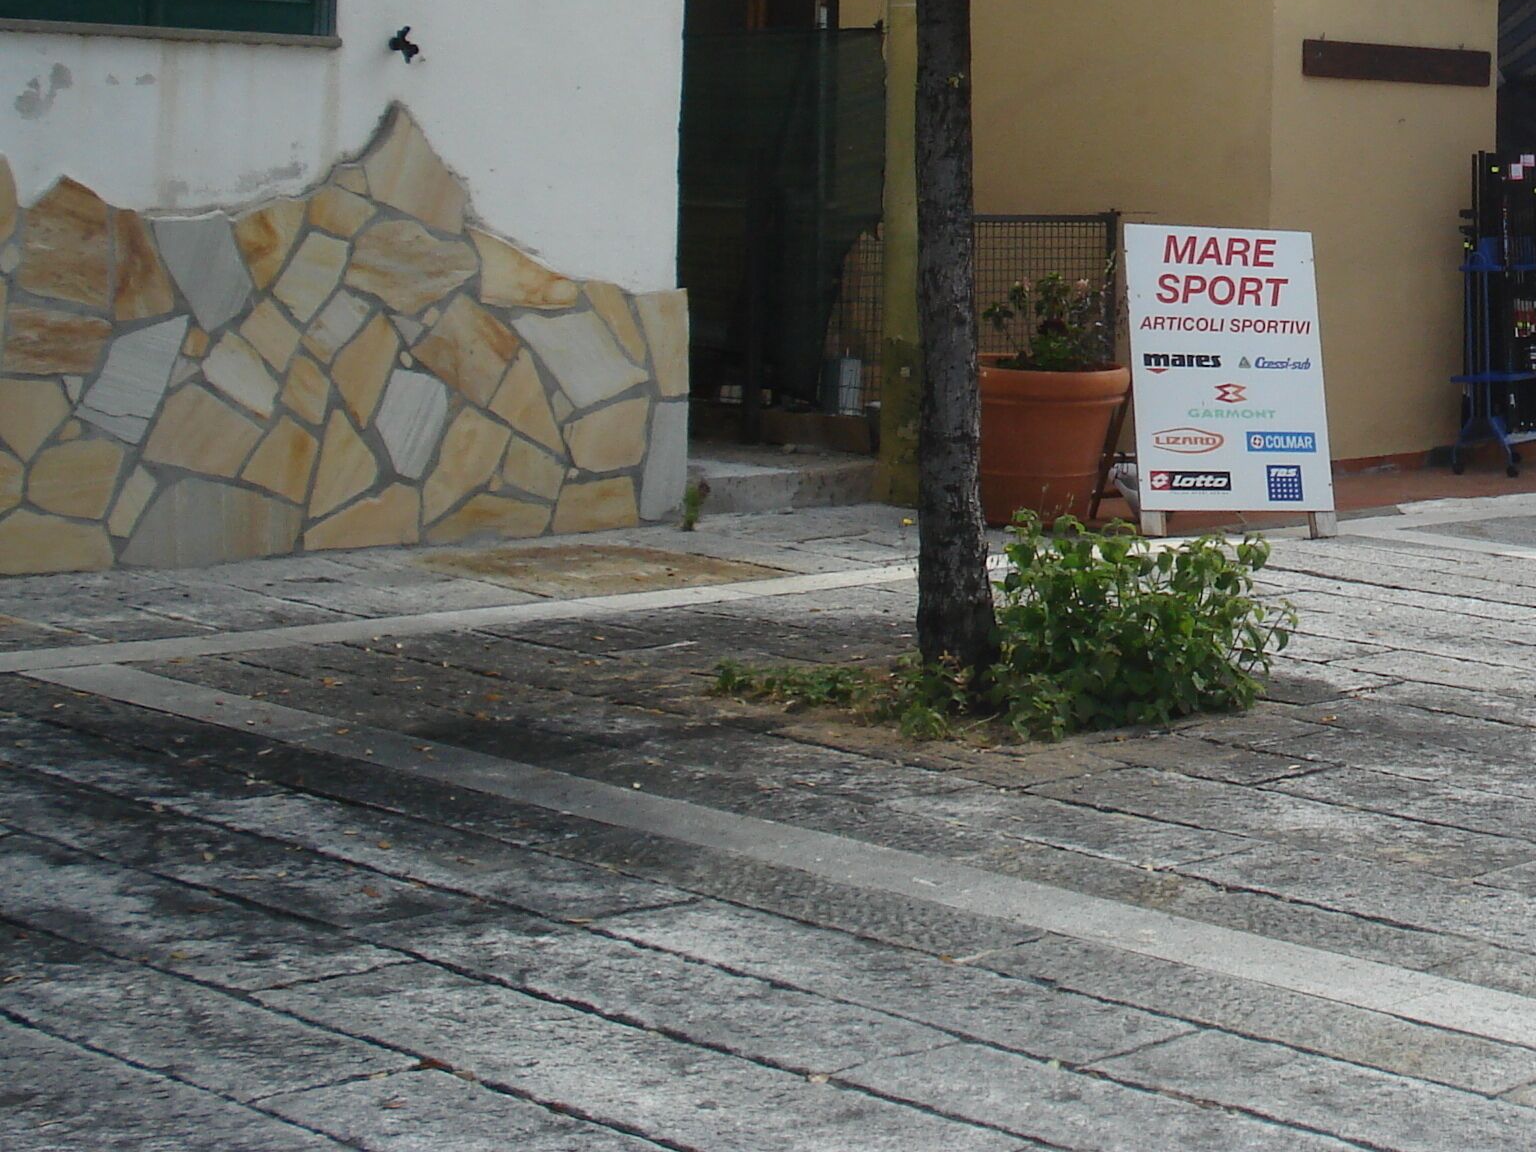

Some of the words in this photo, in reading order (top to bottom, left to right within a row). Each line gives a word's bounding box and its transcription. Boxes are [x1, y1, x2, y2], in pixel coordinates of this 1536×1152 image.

[1163, 234, 1277, 268] MARE
[1155, 273, 1289, 307] SPORT
[1140, 316, 1225, 333] ARTICOLI
[1229, 318, 1311, 335] SPORTIVI
[1143, 353, 1222, 368] mares
[1187, 408, 1276, 419] GARMONT
[1155, 436, 1217, 446] LIZARD
[1265, 436, 1313, 449] COLMAR
